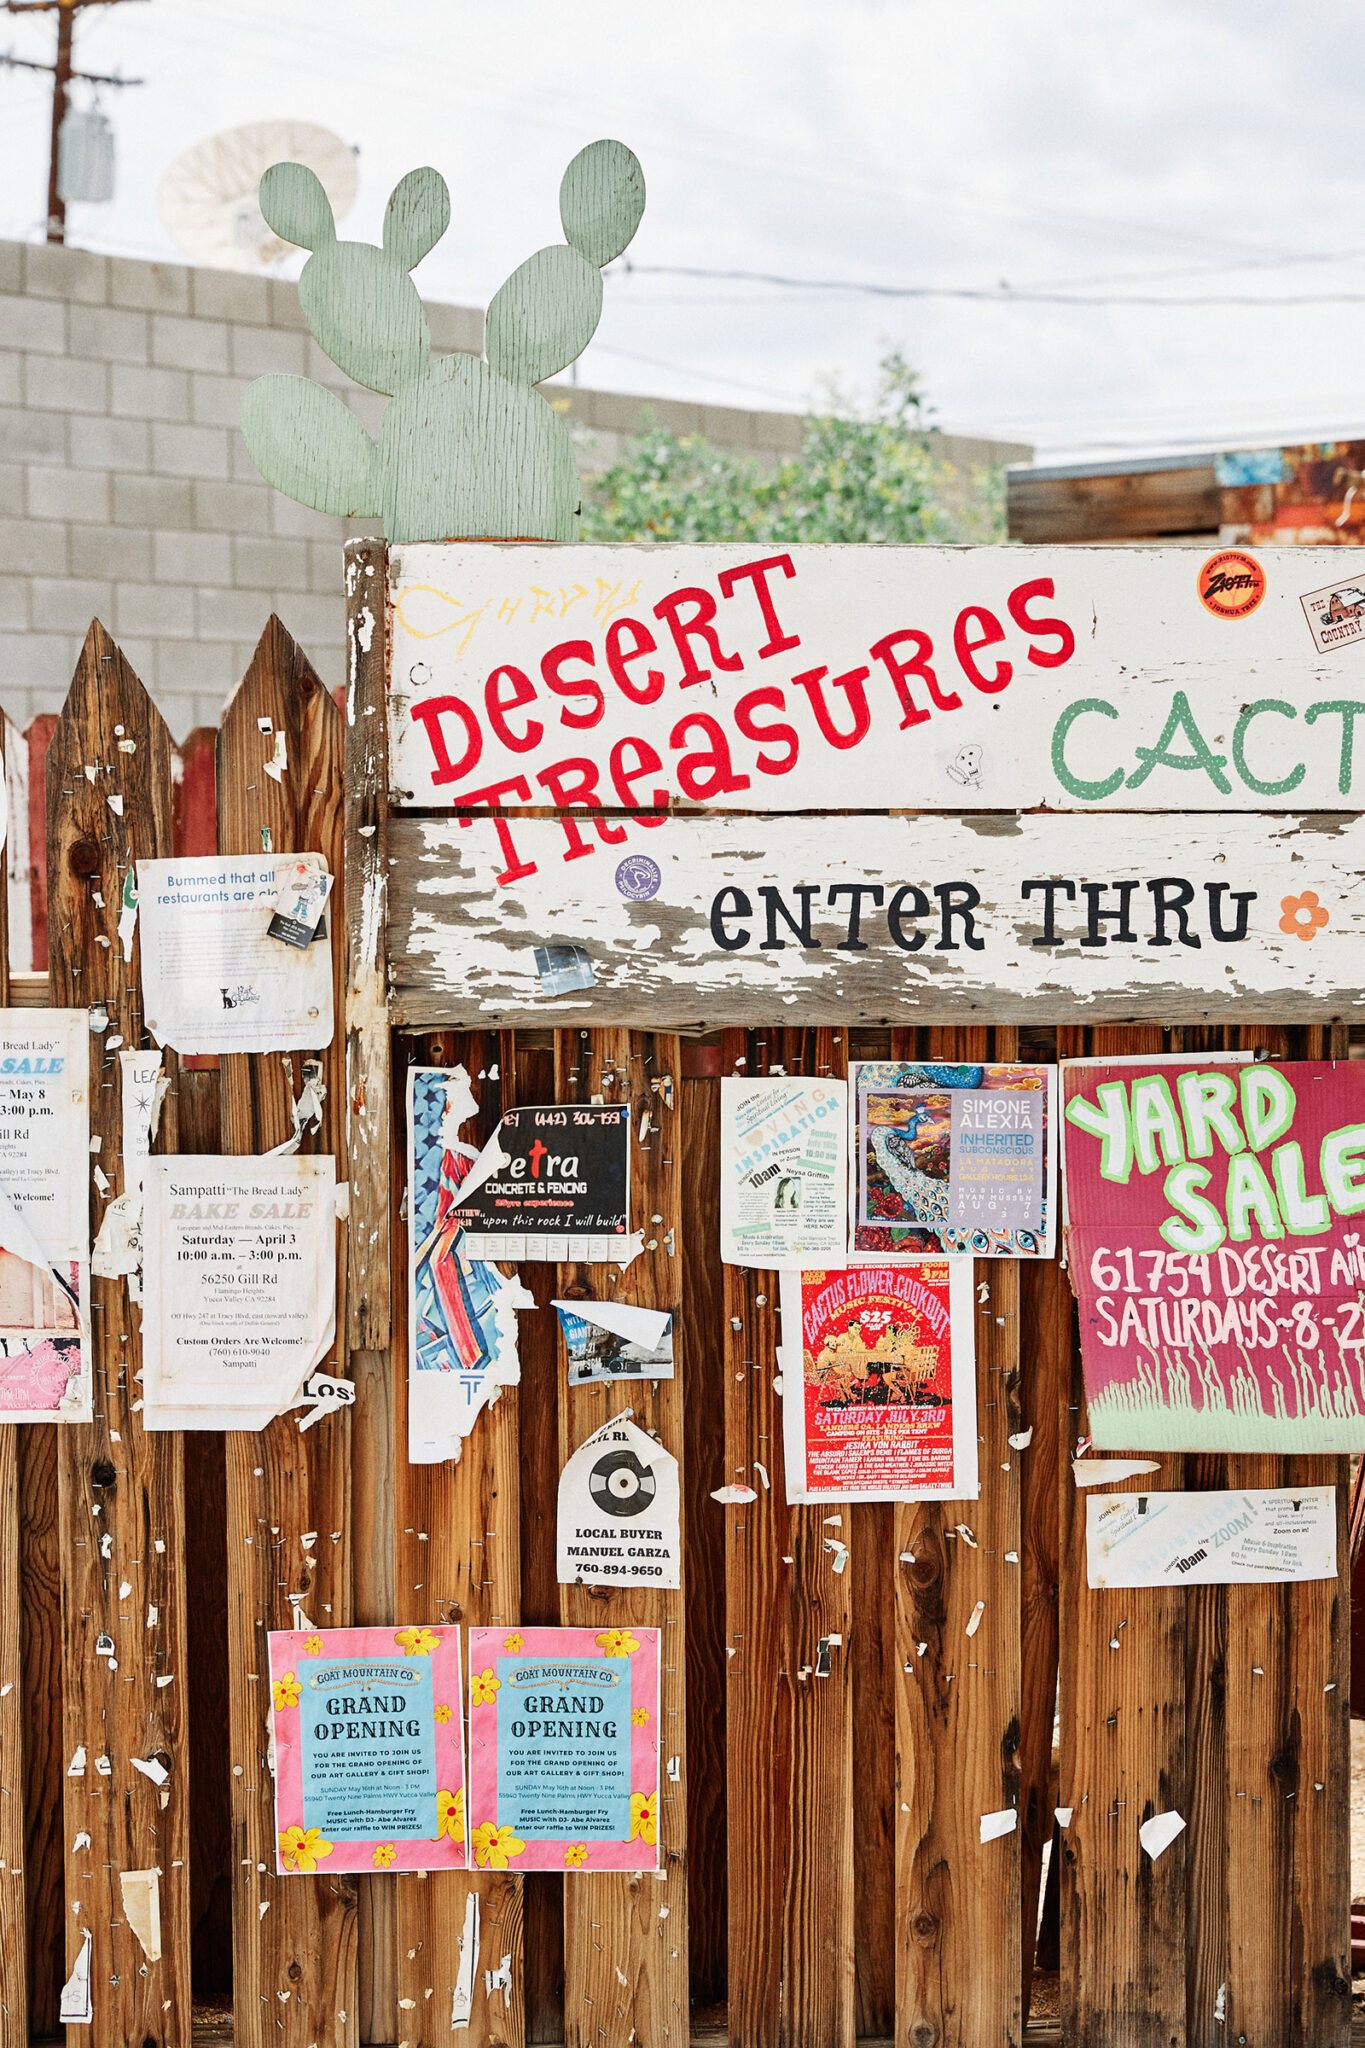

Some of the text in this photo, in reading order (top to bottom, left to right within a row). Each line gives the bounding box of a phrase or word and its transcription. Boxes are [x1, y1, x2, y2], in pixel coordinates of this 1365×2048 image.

[1212, 599, 1257, 615] JOSHUA TREE
[1051, 691, 1365, 800] CACT
[167, 871, 275, 887] Bummed that all
[157, 891, 229, 904] restaurants
[233, 890, 254, 901] are
[1020, 877, 1257, 949] THRU
[3, 1042, 30, 1050] Bread
[0, 1058, 65, 1075] SALE
[9, 1089, 46, 1102] May 8
[736, 1093, 760, 1112] JOIN the
[0, 1106, 54, 1117] 3:00 p.m.
[962, 1099, 1031, 1114] SIMONE
[959, 1113, 1033, 1129] ALEXIA
[1065, 1064, 1297, 1184] YARD
[14, 1130, 29, 1139] Rd
[734, 1097, 840, 1174] INSPIRATION
[960, 1132, 1034, 1146] INHERITED
[959, 1145, 1034, 1155] SUBCONSCIOUS
[976, 1158, 1033, 1167] MATADORA
[748, 1163, 782, 1189] 10am
[786, 1167, 830, 1180] Neysa Griffith
[169, 1183, 226, 1198] Sampatti
[252, 1186, 278, 1196] Bread
[485, 1182, 588, 1194] CONCRETE & FENCING
[1159, 1123, 1365, 1256] SALE
[14, 1193, 55, 1201] Welcome!
[169, 1203, 313, 1220] BAKE SALE
[512, 1214, 534, 1226] this
[537, 1214, 561, 1226] rock
[564, 1214, 574, 1226] I
[575, 1214, 592, 1226] will
[182, 1234, 296, 1247] Saturday April 3
[176, 1250, 302, 1262] 10:00 a.m. 3:00 p.m.
[201, 1273, 278, 1285] 56250 Gill Rd
[1090, 1246, 1210, 1298] 61754
[223, 1295, 243, 1304] Valley
[803, 1270, 950, 1344] CACTUS FLOWER COOKOUT
[829, 1295, 924, 1321] MUSIC FESTIVAL
[859, 1309, 892, 1325] $25
[568, 1326, 591, 1339] GIANT
[176, 1336, 303, 1345] Custom Orders Are Welcome!
[209, 1348, 231, 1357] (760)
[222, 1359, 257, 1369] Sampatti
[303, 1381, 355, 1400] LOS
[814, 1408, 946, 1425] SATURDAY JULY 3RD
[843, 1440, 920, 1450] JESIKA VON RABBIT
[1098, 1508, 1112, 1522] JOIN
[575, 1528, 662, 1540] LOCAL BUYER
[567, 1546, 671, 1558] MANUEL GARZA
[1163, 1555, 1181, 1574] SUNDAY
[1174, 1548, 1208, 1574] 10am
[575, 1563, 663, 1576] 760-894-9650
[317, 1668, 413, 1684] GOAT MOUNTAIN CO
[515, 1668, 612, 1682] GOAT MOUNTAIN CO
[325, 1695, 407, 1715] GRAND
[523, 1696, 604, 1713] GRAND
[314, 1719, 421, 1740] OPENING
[511, 1720, 617, 1738] OPENING
